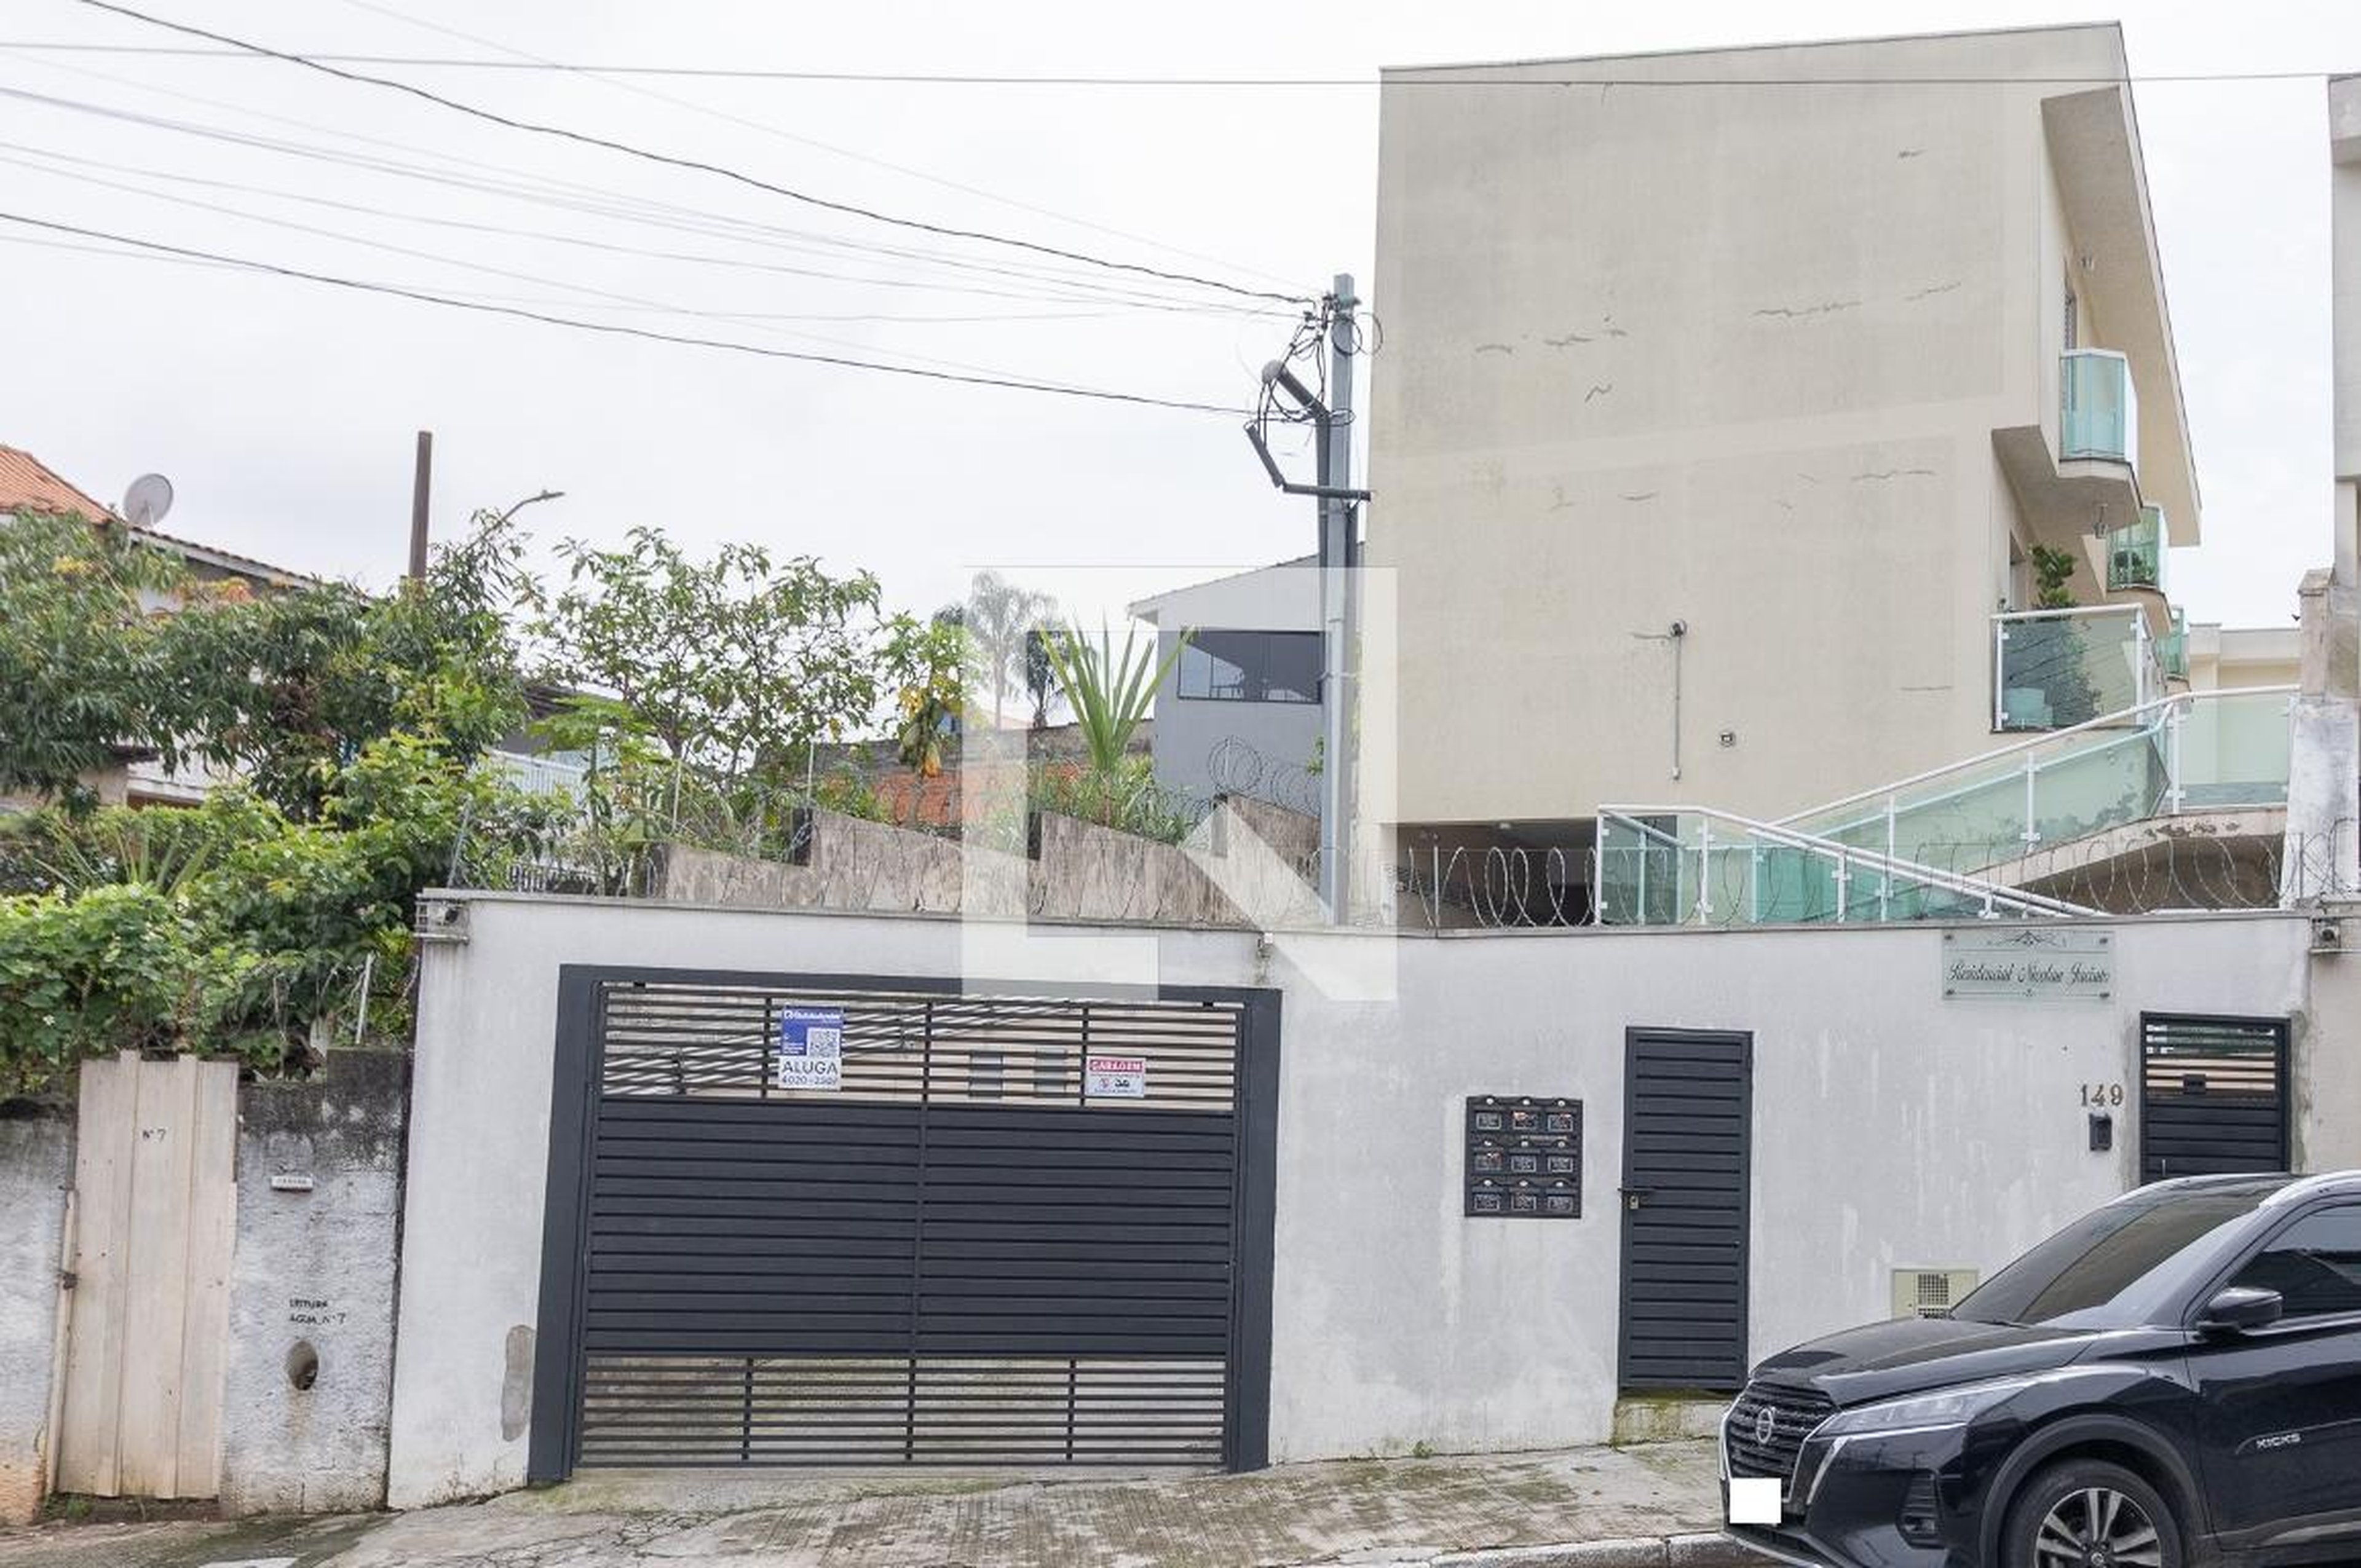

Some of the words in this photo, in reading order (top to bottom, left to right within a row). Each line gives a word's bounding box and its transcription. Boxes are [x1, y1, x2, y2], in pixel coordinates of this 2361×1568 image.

[782, 1061, 837, 1074] ALUGA
[2080, 1083, 2124, 1106] 149
[157, 1129, 166, 1142] 7
[2256, 1433, 2301, 1449] KICKS
